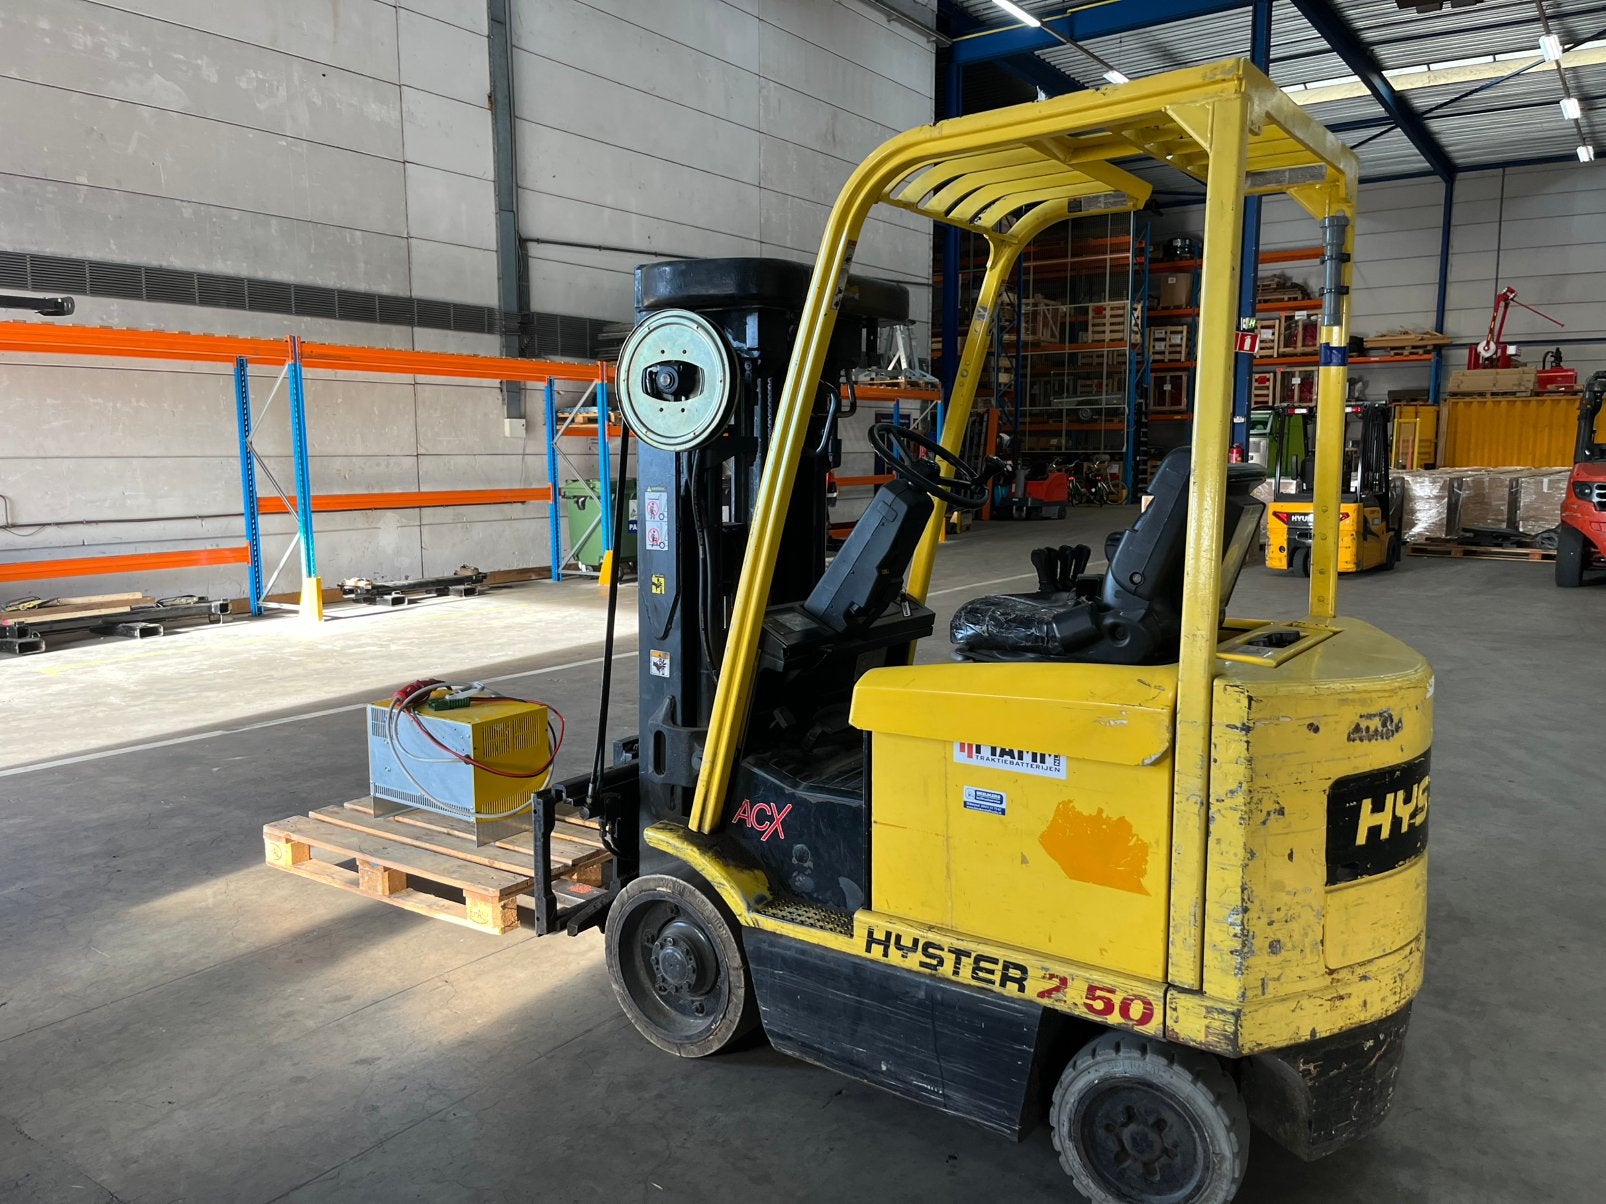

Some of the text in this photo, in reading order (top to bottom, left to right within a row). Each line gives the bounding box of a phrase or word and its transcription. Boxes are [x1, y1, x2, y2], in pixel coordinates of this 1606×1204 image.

[975, 754, 1061, 773] TRAKTIEBATTERIJEN
[731, 798, 793, 842] ACX
[864, 925, 1029, 994] HYSTER
